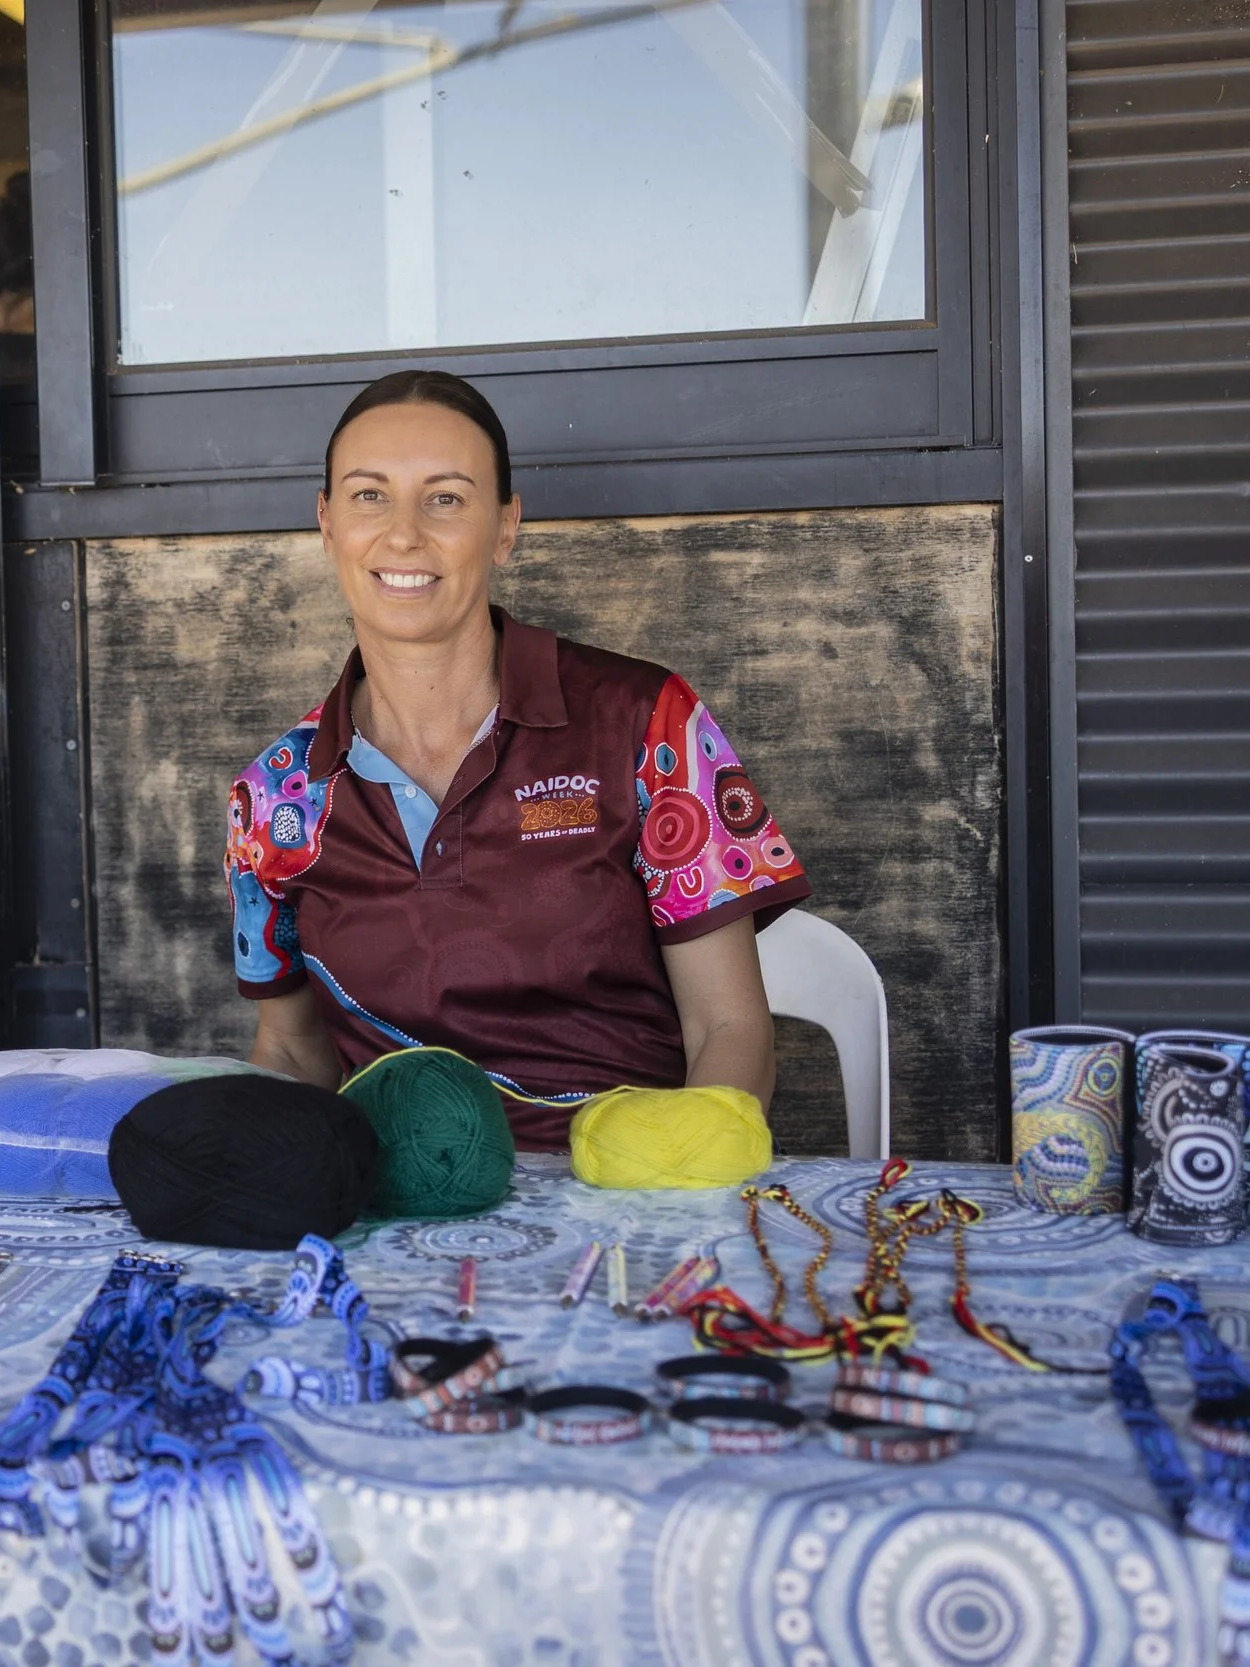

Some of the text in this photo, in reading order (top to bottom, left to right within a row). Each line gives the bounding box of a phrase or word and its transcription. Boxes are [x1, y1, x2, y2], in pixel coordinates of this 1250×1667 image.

[514, 775, 600, 801] NAIDOC
[541, 790, 573, 800] WEEK
[520, 797, 598, 831] 2026
[533, 829, 561, 840] YEARS
[568, 826, 596, 835] DEADLY
